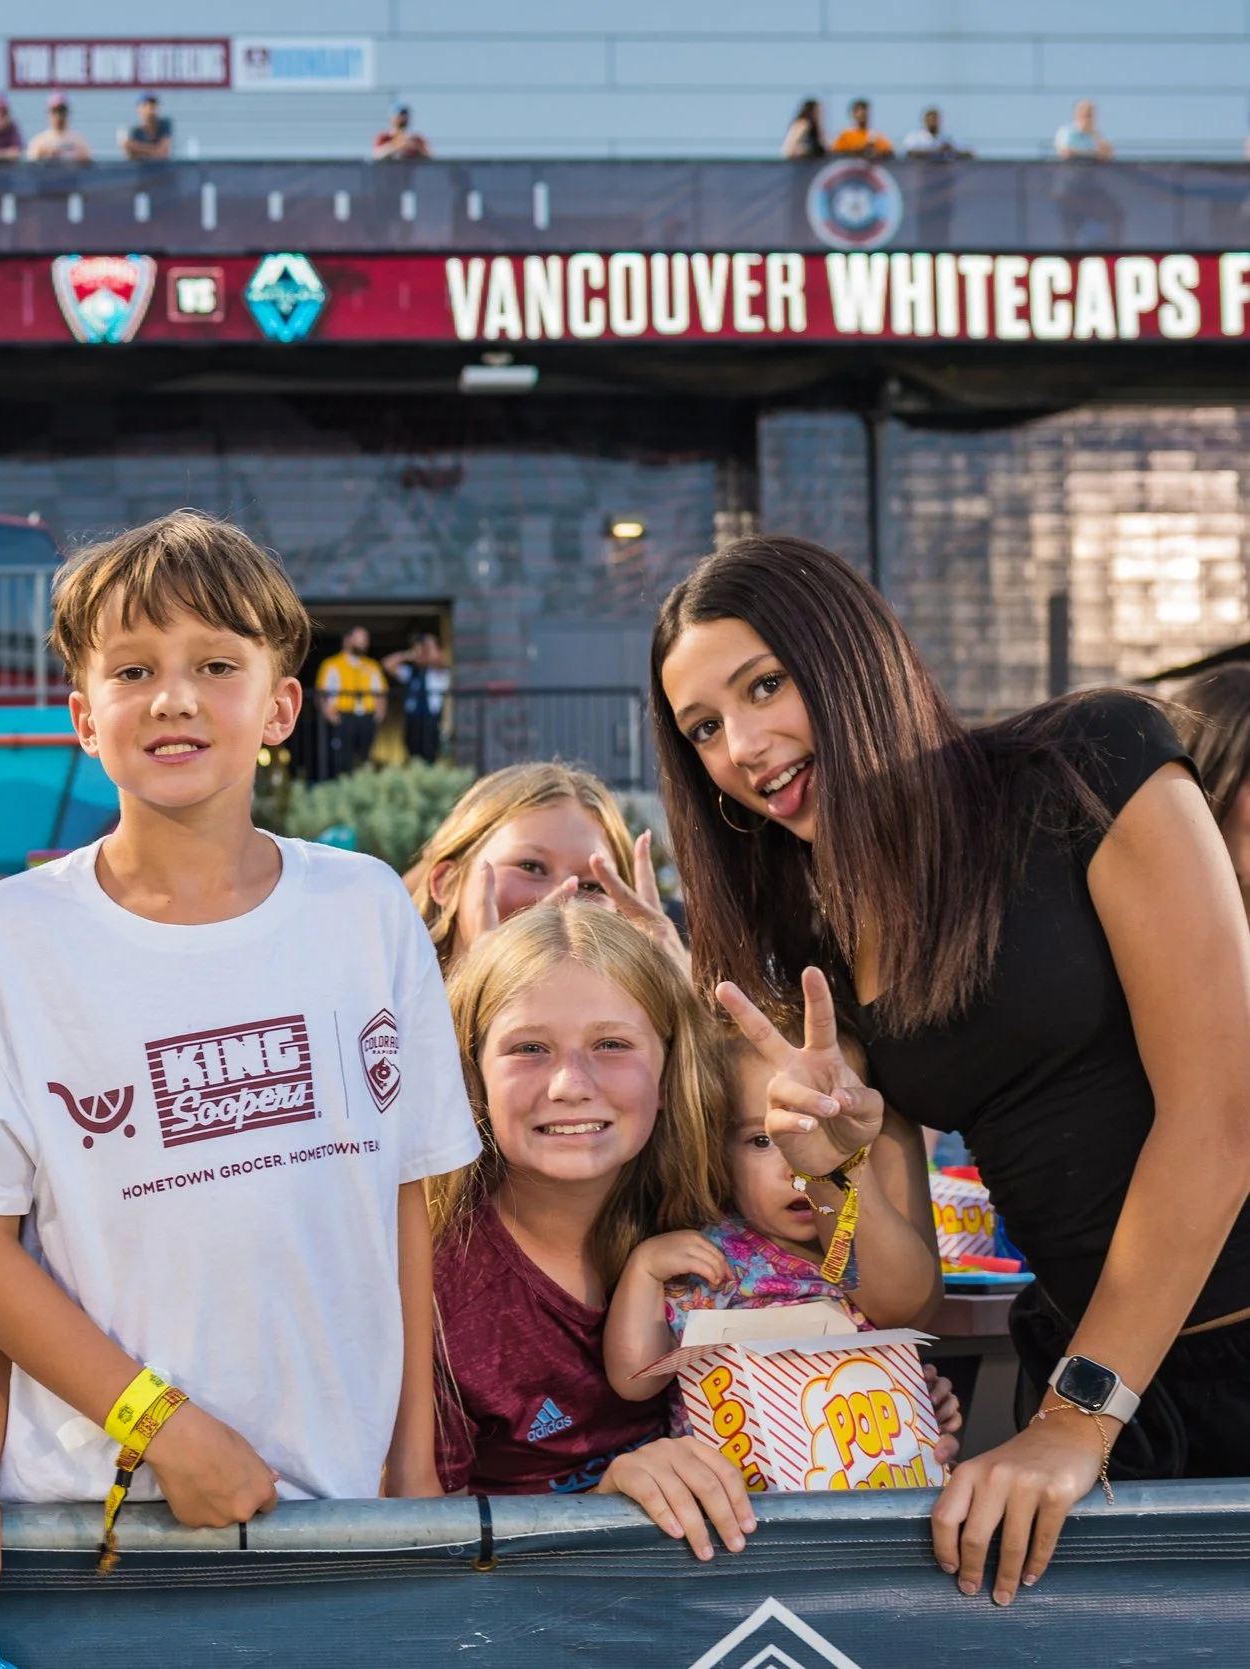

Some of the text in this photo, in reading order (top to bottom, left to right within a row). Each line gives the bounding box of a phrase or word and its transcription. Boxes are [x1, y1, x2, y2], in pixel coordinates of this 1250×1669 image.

[176, 277, 217, 314] VS
[445, 252, 807, 341] VANCOUVER
[824, 252, 1201, 341] WHITECAPS
[158, 1028, 301, 1095] KING
[168, 1082, 308, 1132] Soopers
[121, 1167, 215, 1201] HOMETOWN
[219, 1153, 287, 1179] GROCER.
[289, 1141, 361, 1165] HOMETOWN
[526, 1415, 574, 1443] adidas
[821, 1388, 902, 1471] POP
